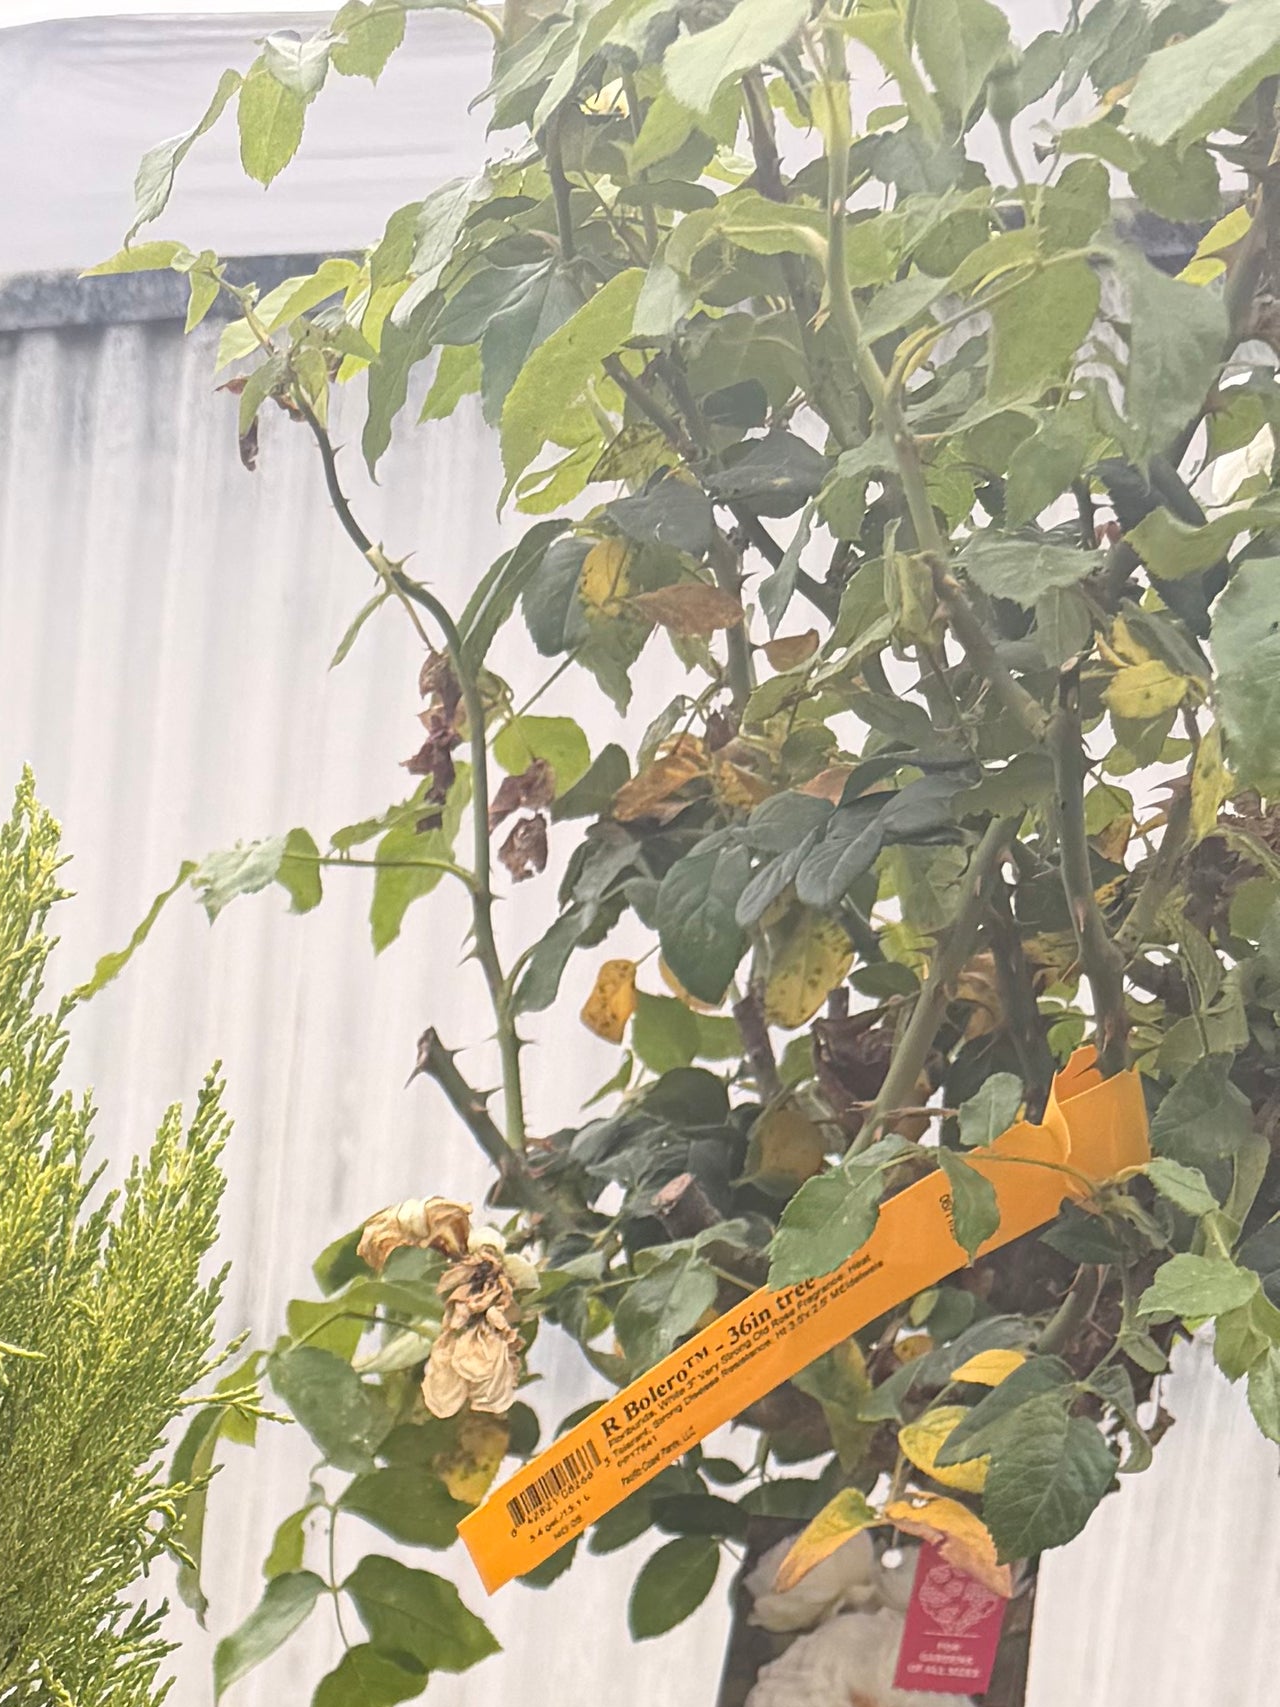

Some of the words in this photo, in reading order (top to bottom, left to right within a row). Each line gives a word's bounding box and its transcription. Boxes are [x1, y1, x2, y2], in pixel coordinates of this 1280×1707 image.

[601, 1414, 618, 1438] R
[726, 1302, 770, 1346] 36in
[776, 1273, 815, 1310] tree
[721, 1338, 749, 1365] Strong
